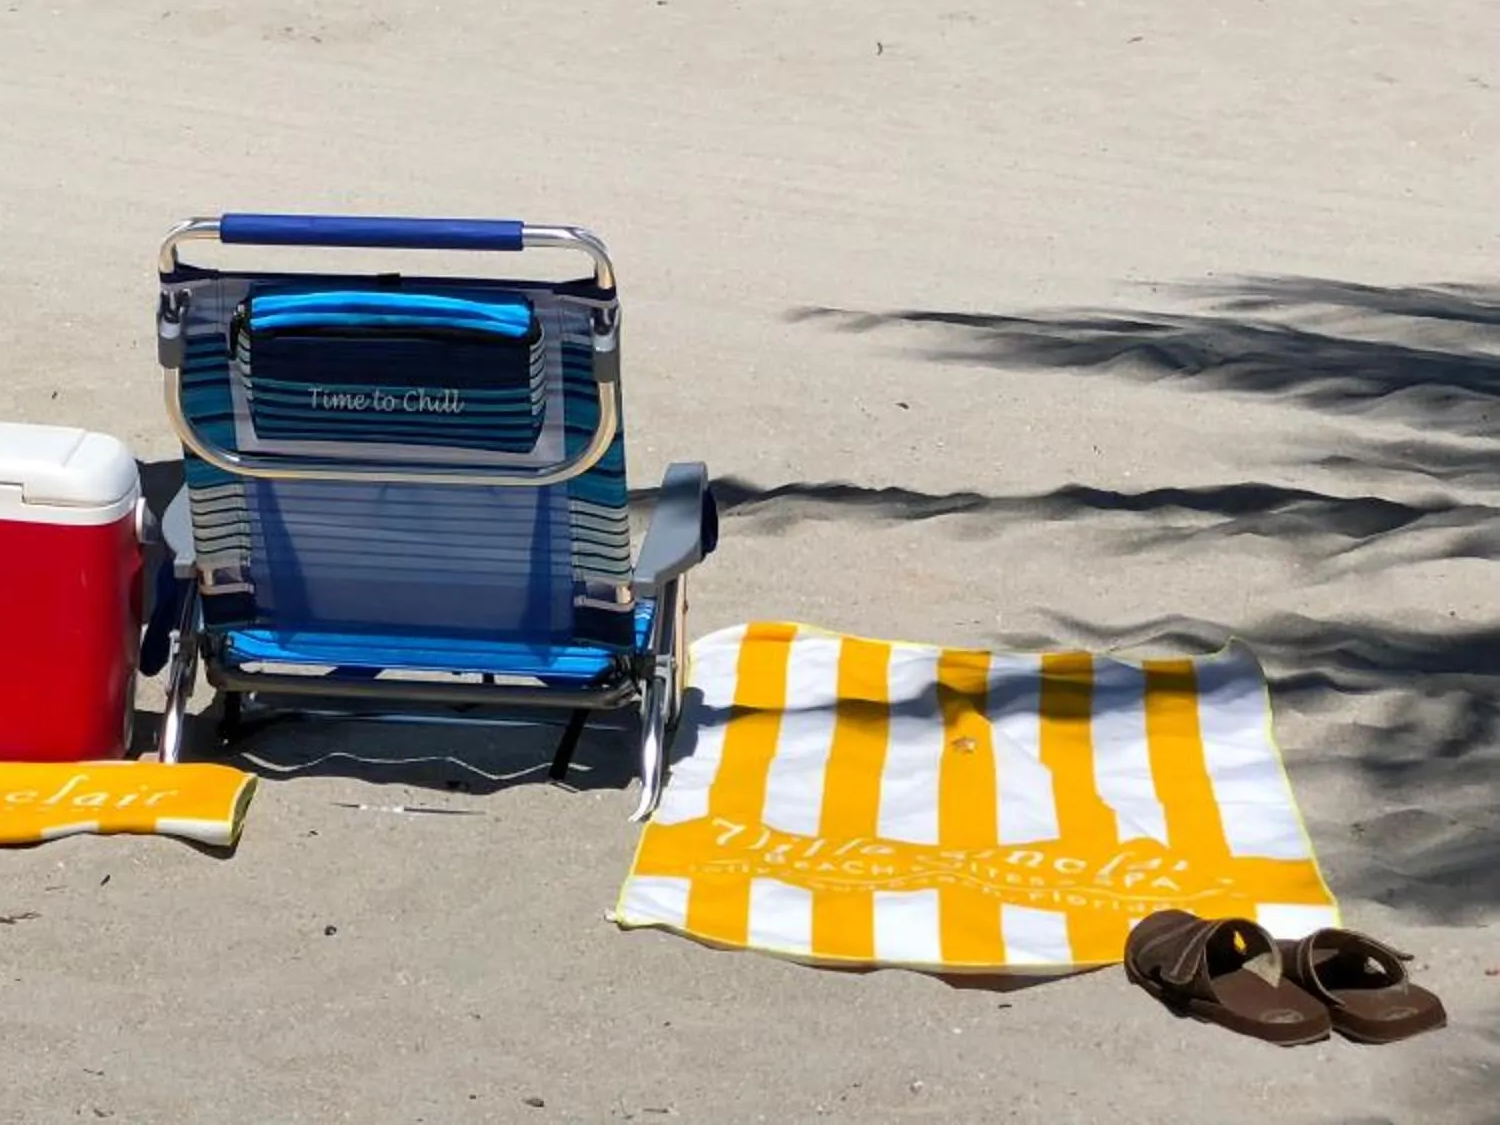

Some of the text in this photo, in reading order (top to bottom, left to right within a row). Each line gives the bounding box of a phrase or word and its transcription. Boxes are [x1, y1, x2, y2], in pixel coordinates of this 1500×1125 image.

[309, 387, 465, 414] Time to Chill
